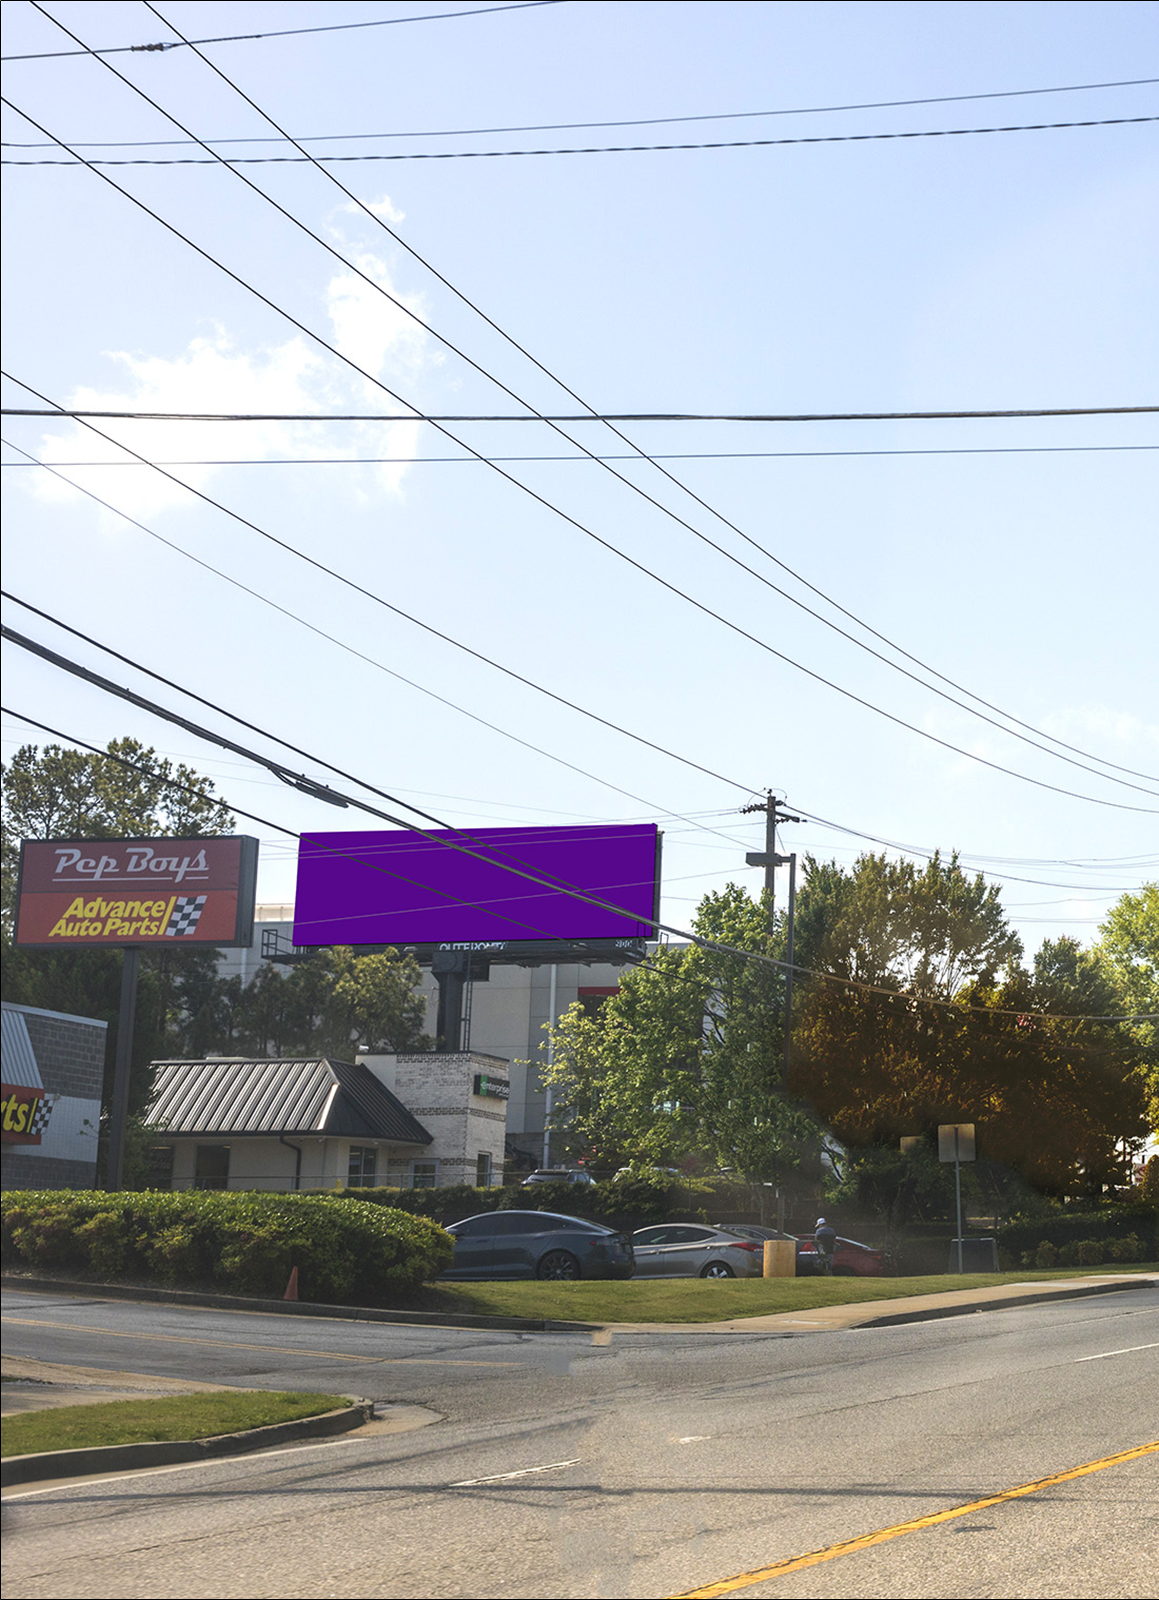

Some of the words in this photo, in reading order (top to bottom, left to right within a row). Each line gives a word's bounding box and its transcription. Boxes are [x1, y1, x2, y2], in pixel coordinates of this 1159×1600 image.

[55, 848, 119, 879] Pep
[126, 847, 210, 883] Boys
[62, 897, 166, 919] Advance
[48, 918, 102, 937] Auto
[102, 917, 160, 937] Parts
